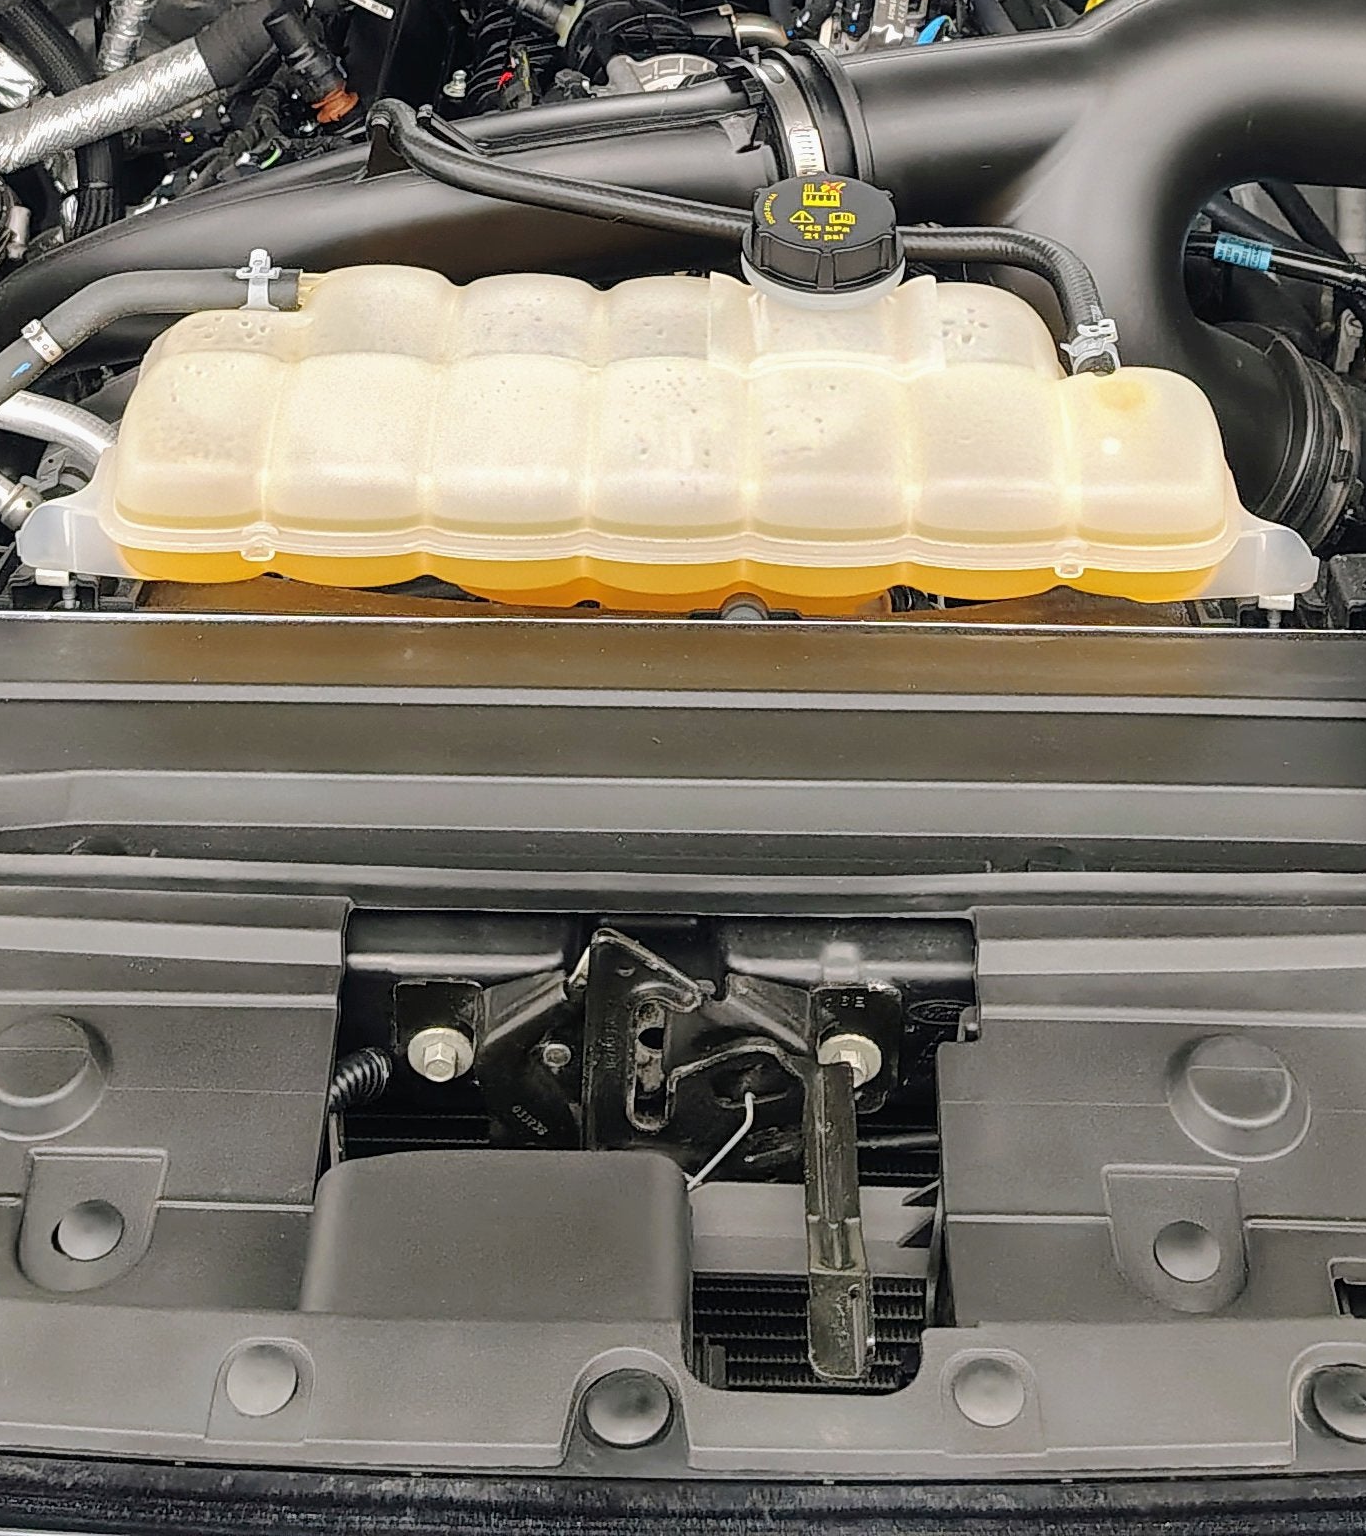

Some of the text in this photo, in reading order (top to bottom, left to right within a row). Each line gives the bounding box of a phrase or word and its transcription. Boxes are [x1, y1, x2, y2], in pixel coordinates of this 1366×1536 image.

[797, 224, 851, 233] 145 kPa
[803, 232, 844, 241] 21 psi
